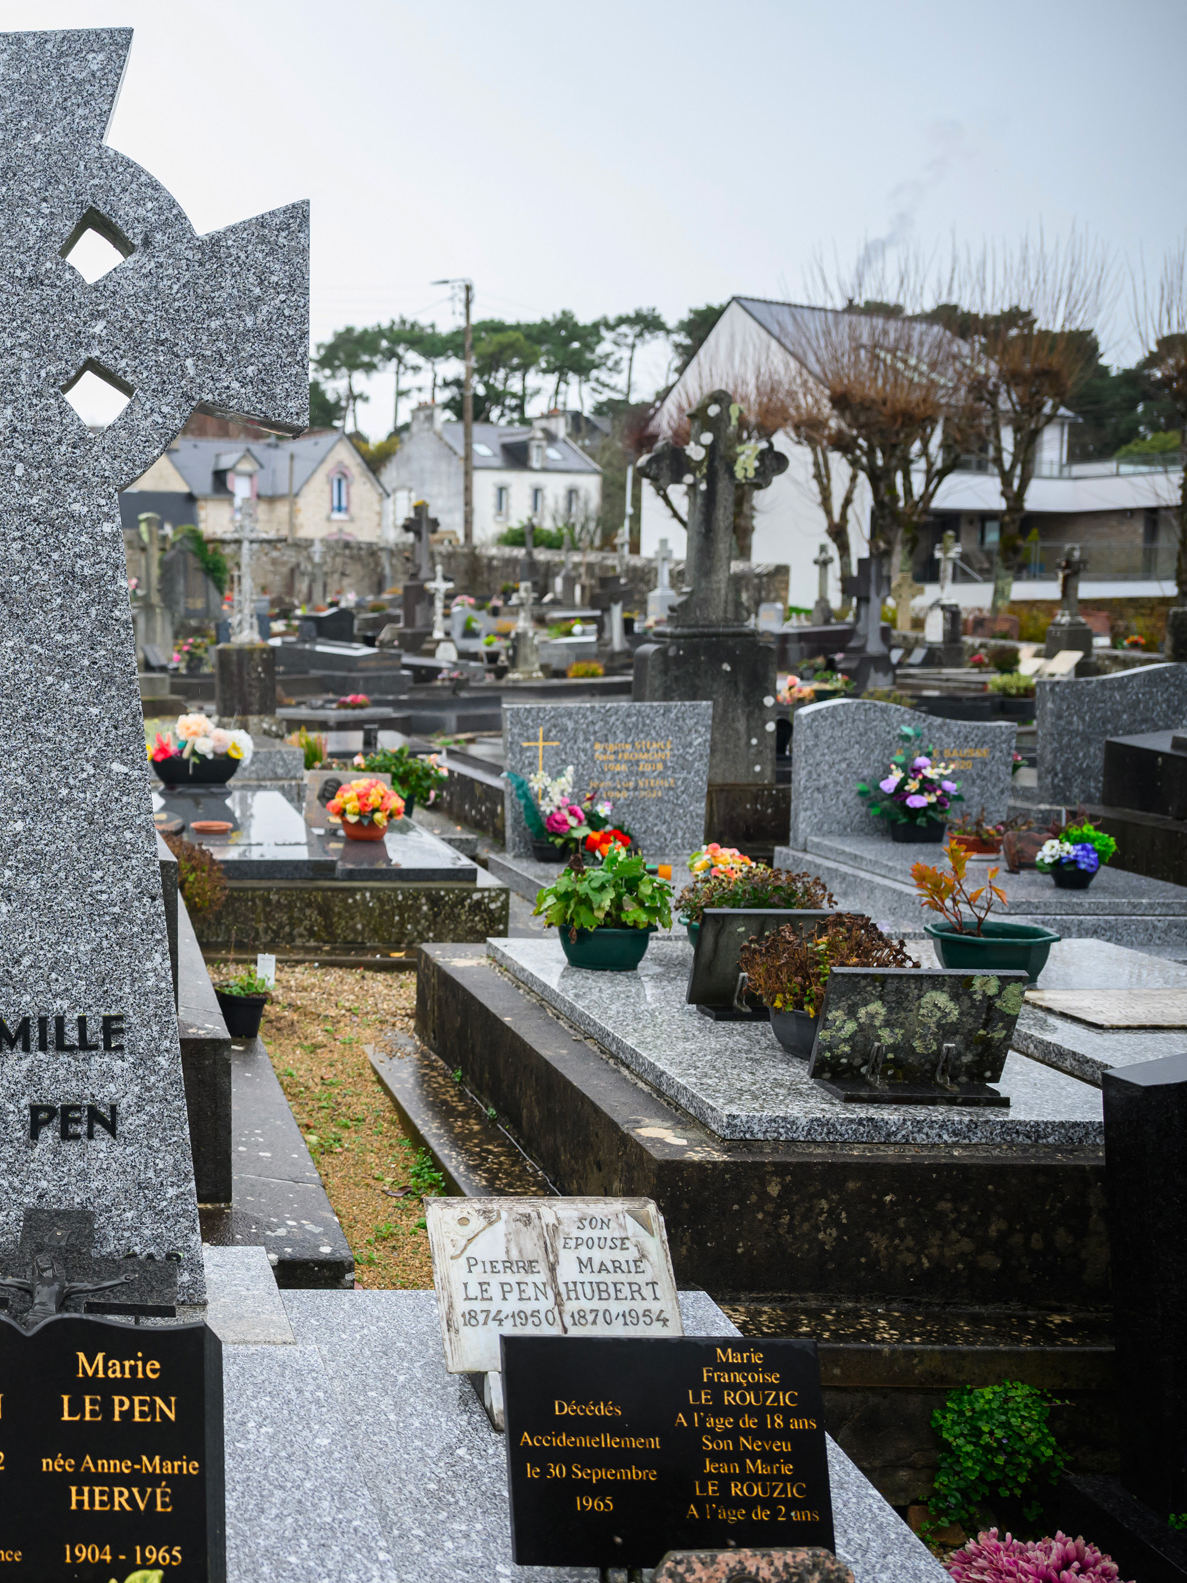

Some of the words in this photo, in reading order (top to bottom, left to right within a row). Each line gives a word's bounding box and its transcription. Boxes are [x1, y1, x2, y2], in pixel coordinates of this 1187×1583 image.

[618, 751, 671, 761] FROMONT
[29, 1103, 118, 1141] PEN
[577, 1216, 612, 1231] SON
[562, 1236, 631, 1251] EPOUSE
[466, 1256, 541, 1275] PIERRE
[576, 1256, 646, 1274] MARIE
[463, 1282, 494, 1301] LE
[501, 1282, 549, 1301] PEN
[562, 1281, 662, 1301] HUBERT
[716, 1347, 764, 1364] Marie
[76, 1352, 162, 1379] Marie
[702, 1366, 781, 1387] Françoise
[688, 1389, 713, 1405] LE
[723, 1389, 798, 1407] ROUZIC
[61, 1395, 102, 1421] LE
[112, 1395, 177, 1422] PEN
[554, 1400, 622, 1417] Décédés
[674, 1412, 688, 1427] A
[739, 1413, 759, 1428] de
[766, 1413, 784, 1429] 18
[789, 1417, 818, 1430] ans
[519, 1431, 661, 1449] Accidentellement
[702, 1434, 734, 1451] Son
[739, 1435, 792, 1452] Neveu
[42, 1453, 75, 1473] née
[80, 1454, 200, 1475] Anne-Marie
[526, 1463, 541, 1478] le
[546, 1463, 566, 1479] 30
[571, 1464, 658, 1483] Septembre
[703, 1457, 740, 1474] Jean
[745, 1458, 794, 1475] Marie
[69, 1481, 173, 1512] HERVÉ
[694, 1480, 720, 1496] LE
[730, 1480, 807, 1498] ROUZIC
[576, 1496, 614, 1512] 1965
[686, 1503, 700, 1519] A
[751, 1505, 771, 1521] de
[776, 1505, 787, 1520] 2
[792, 1509, 820, 1521] ans
[64, 1543, 113, 1564] 1904
[133, 1545, 183, 1566] 1965
